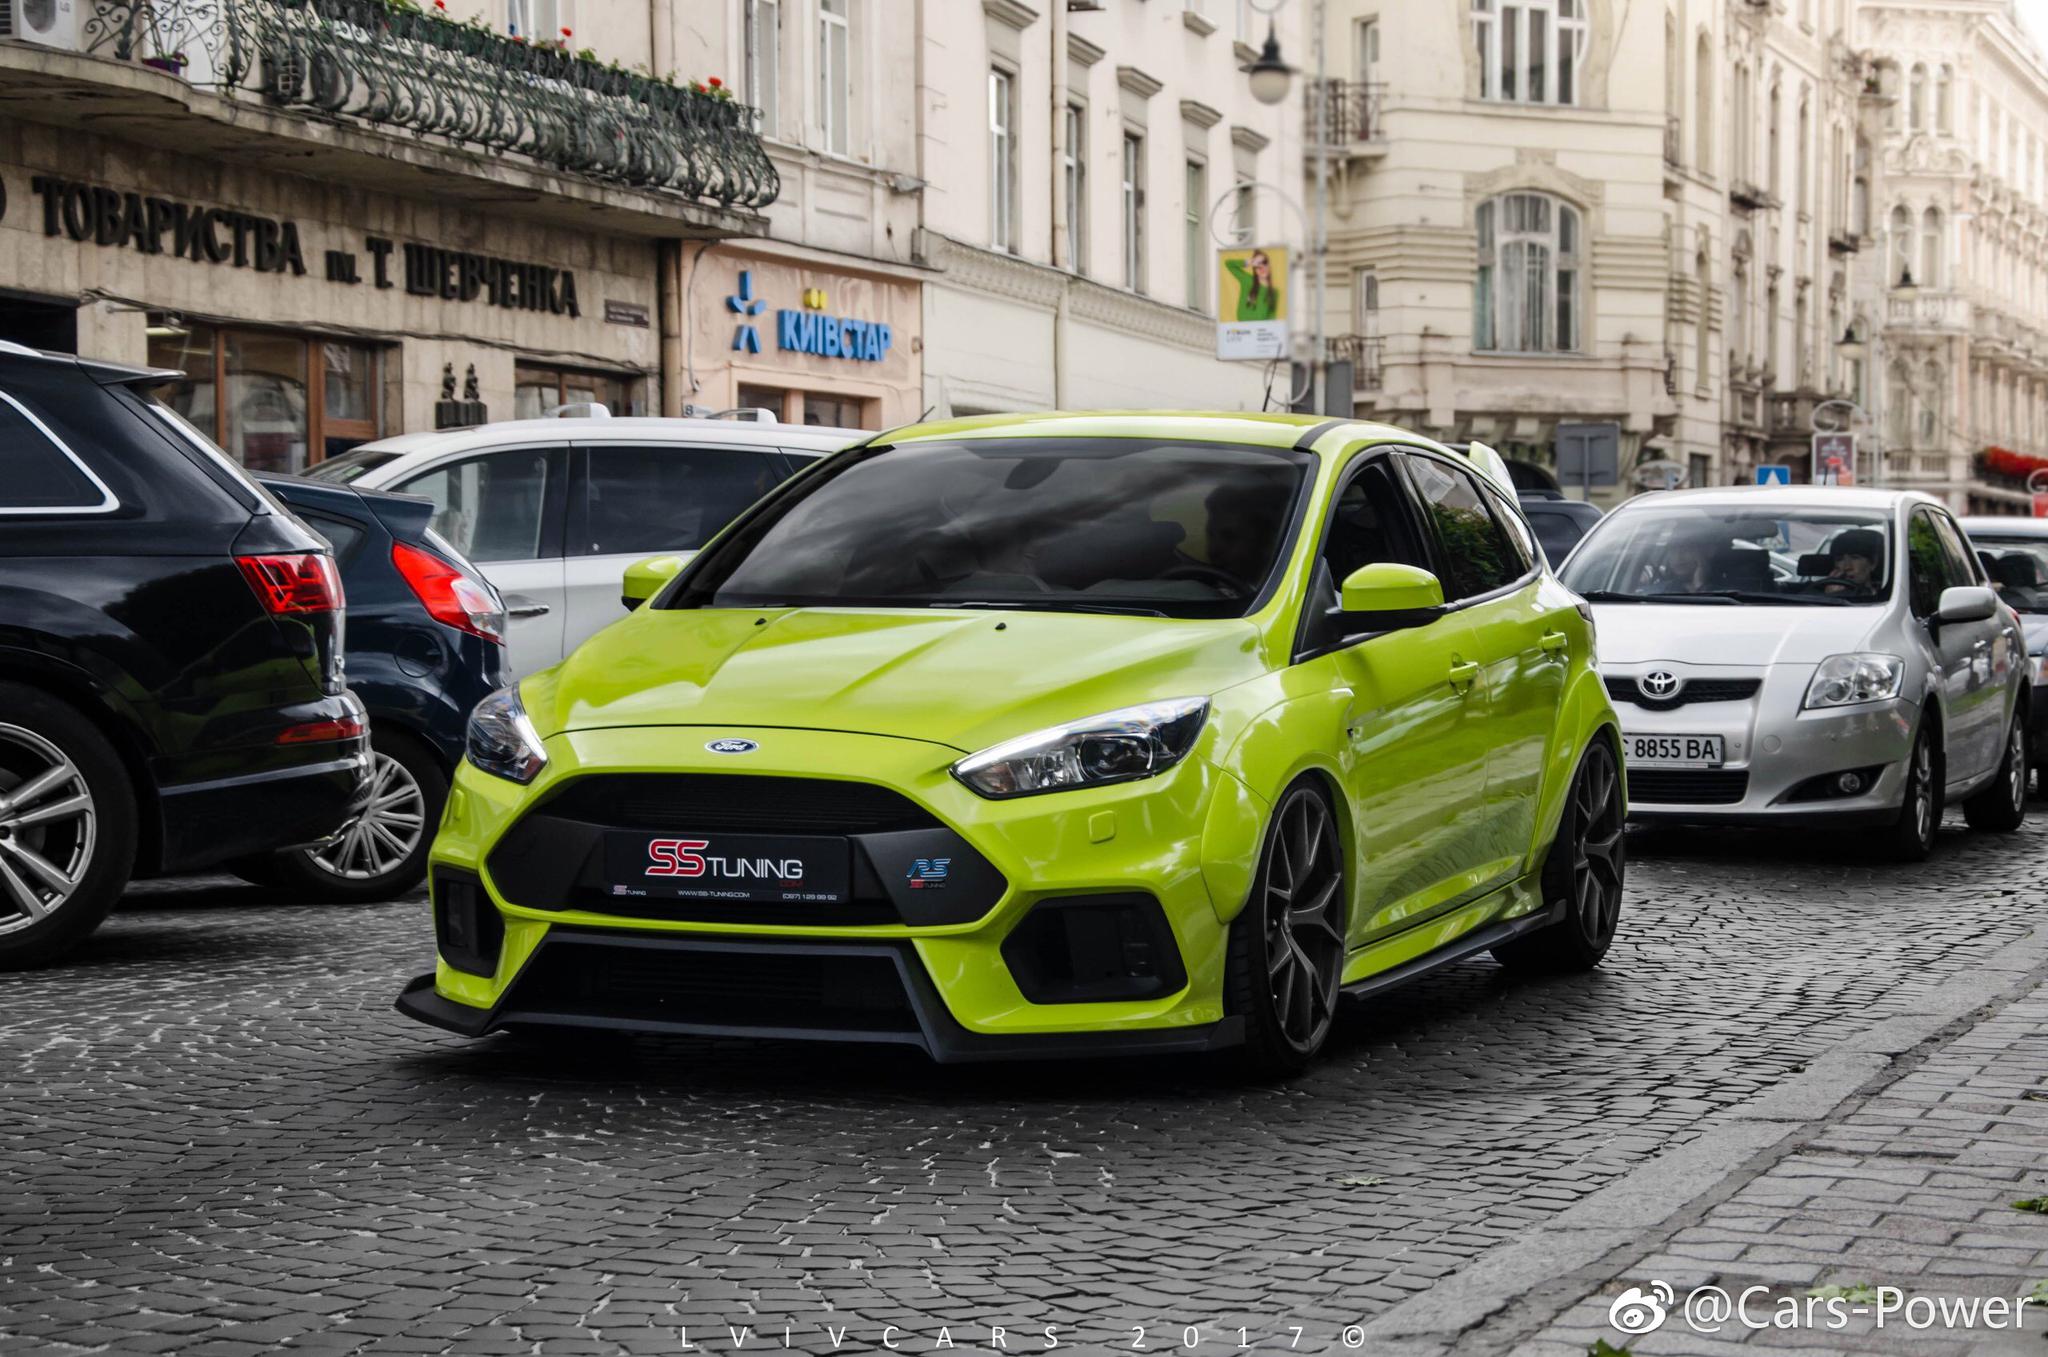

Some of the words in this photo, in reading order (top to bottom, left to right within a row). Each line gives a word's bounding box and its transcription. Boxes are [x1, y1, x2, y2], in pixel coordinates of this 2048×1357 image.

[31, 175, 306, 276] ТОВАРИСТВА
[403, 242, 581, 318] ШЕВЧЕНКА
[777, 288, 893, 362] КИЇВСТАР
[1635, 738, 1681, 758] 8855
[1686, 739, 1716, 760] BA
[905, 858, 952, 878] RS
